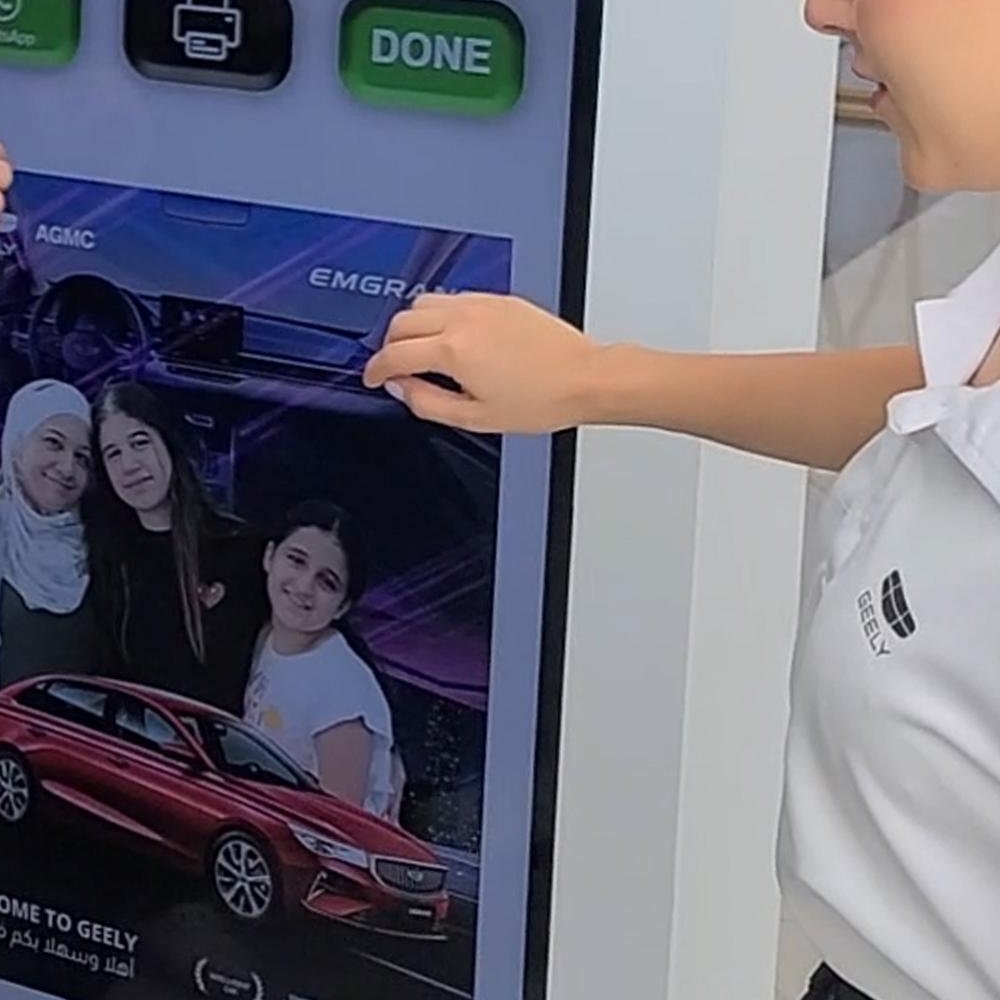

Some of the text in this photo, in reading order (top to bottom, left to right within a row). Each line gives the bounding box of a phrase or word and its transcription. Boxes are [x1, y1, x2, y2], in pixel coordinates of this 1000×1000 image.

[371, 27, 492, 75] DONE
[34, 223, 96, 250] AGMC
[309, 266, 458, 300] EMGRA
[857, 589, 891, 658] GEELY
[8, 928, 40, 954] بكم
[44, 907, 73, 933] TO
[76, 919, 140, 953] GEELY
[43, 936, 100, 973] وسهلا
